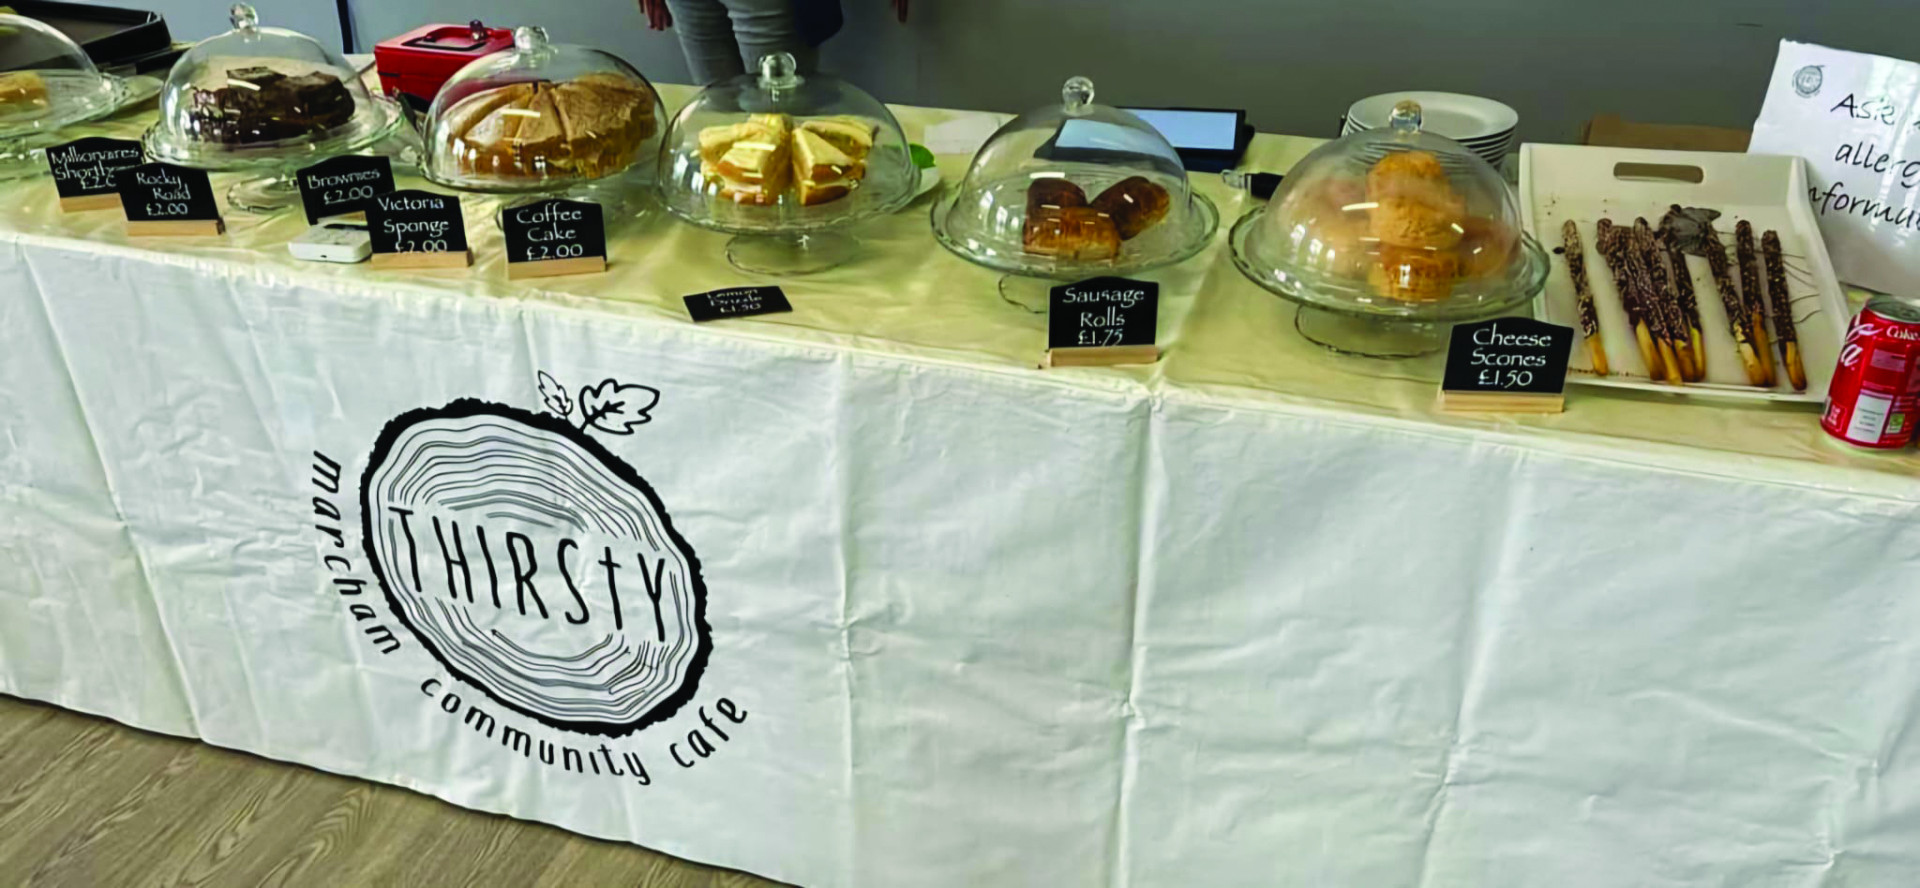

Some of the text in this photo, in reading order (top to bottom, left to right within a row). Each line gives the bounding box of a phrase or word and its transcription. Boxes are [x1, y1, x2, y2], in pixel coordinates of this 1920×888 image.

[136, 167, 182, 190] Rocky
[307, 168, 380, 190] Brownies
[152, 183, 191, 200] Road
[323, 185, 373, 205] £2.00
[145, 202, 188, 216] £2.00
[377, 196, 444, 211] Victoria
[516, 202, 582, 224] Coffee
[1808, 181, 1920, 231] nforma
[383, 219, 450, 241] Sponge
[527, 222, 577, 242] Cake
[526, 243, 583, 261] £2.00
[1063, 287, 1145, 309] Sausage
[1080, 305, 1125, 327] Rolls
[1078, 328, 1123, 346] £1.75
[1473, 322, 1552, 347] Cheese
[1470, 347, 1546, 366] Scones
[1478, 369, 1533, 389] £1.50
[312, 450, 748, 786] marcham community cafe
